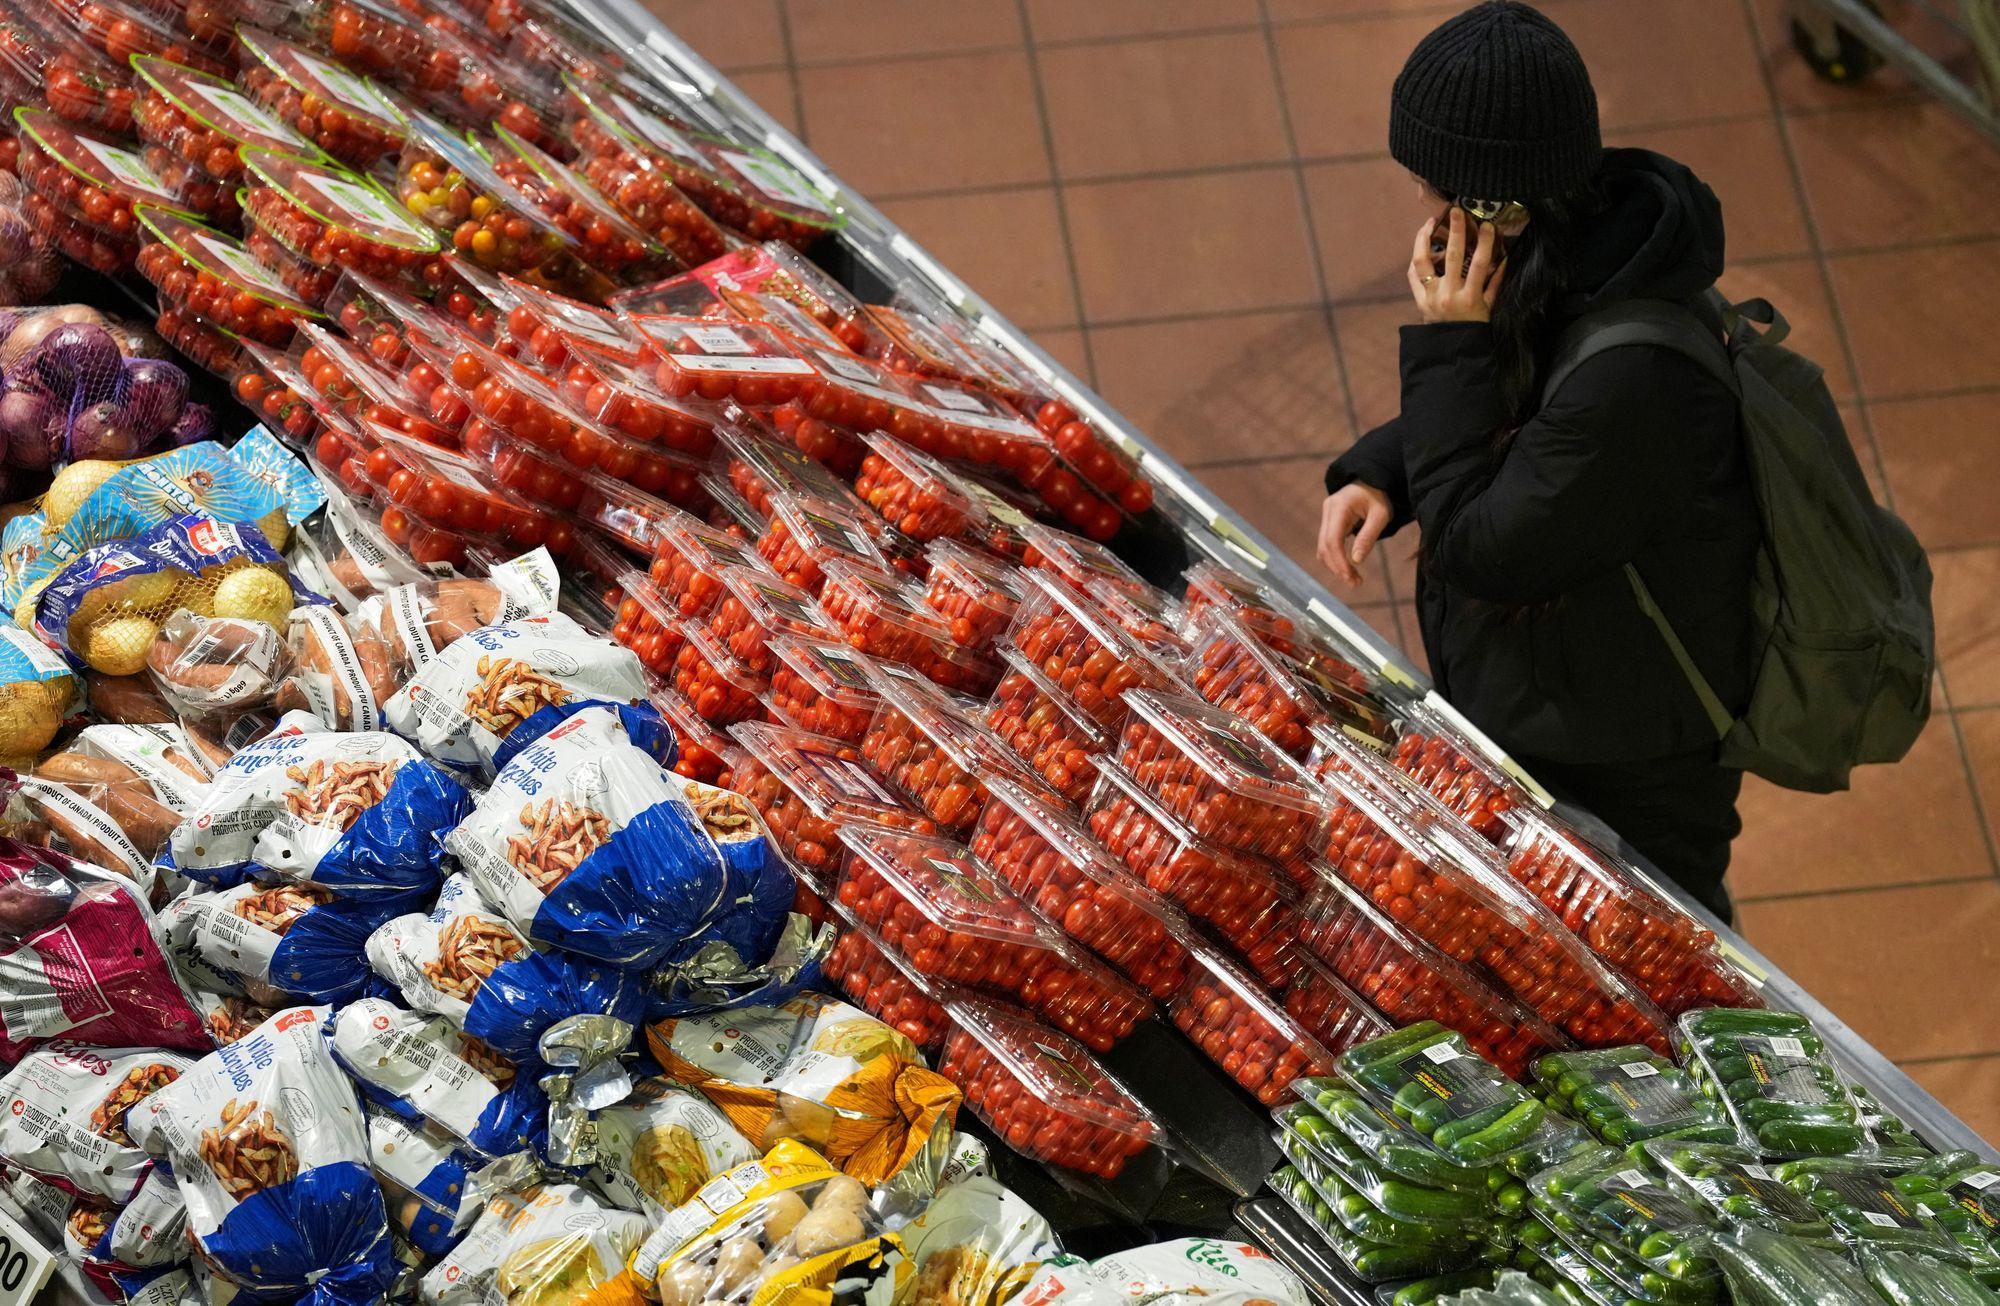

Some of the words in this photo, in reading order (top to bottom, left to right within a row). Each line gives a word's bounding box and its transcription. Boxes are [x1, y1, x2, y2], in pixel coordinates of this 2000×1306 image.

[416, 643, 426, 653] DU
[335, 641, 350, 667] CANADA
[347, 668, 366, 695] PRODUIT
[358, 693, 367, 704] DU
[240, 810, 250, 821] OF
[250, 809, 275, 820] CANADA
[62, 797, 70, 805] OF
[68, 802, 93, 821] CANADA
[93, 818, 121, 843] PRODUIT
[118, 839, 129, 850] DU
[127, 848, 149, 876] CANADA
[211, 823, 241, 836] PRODUIT
[243, 822, 253, 831] DU
[483, 866, 503, 889] CANADA
[489, 855, 510, 878] CANADA
[215, 912, 237, 930] CANADA
[211, 923, 232, 942] CANADA
[246, 1034, 274, 1070] White
[393, 1045, 406, 1056] DU
[411, 1038, 438, 1060] CANADA
[731, 1042, 760, 1065] PRODUIT
[757, 1061, 769, 1072] DU
[739, 1034, 769, 1059] PRODUCT
[766, 1054, 778, 1066] OF
[31, 1062, 61, 1081] POTATOES
[39, 1076, 49, 1085] DE
[49, 1080, 71, 1096] TERRE
[23, 1104, 52, 1129] PRODUCT
[74, 1128, 93, 1148] CANADA
[19, 1116, 44, 1138] PRODUIT
[70, 1141, 88, 1159] CANADA
[168, 1126, 186, 1149] CANADA
[149, 1295, 161, 1305] lb
[160, 1282, 175, 1300] 2.27
